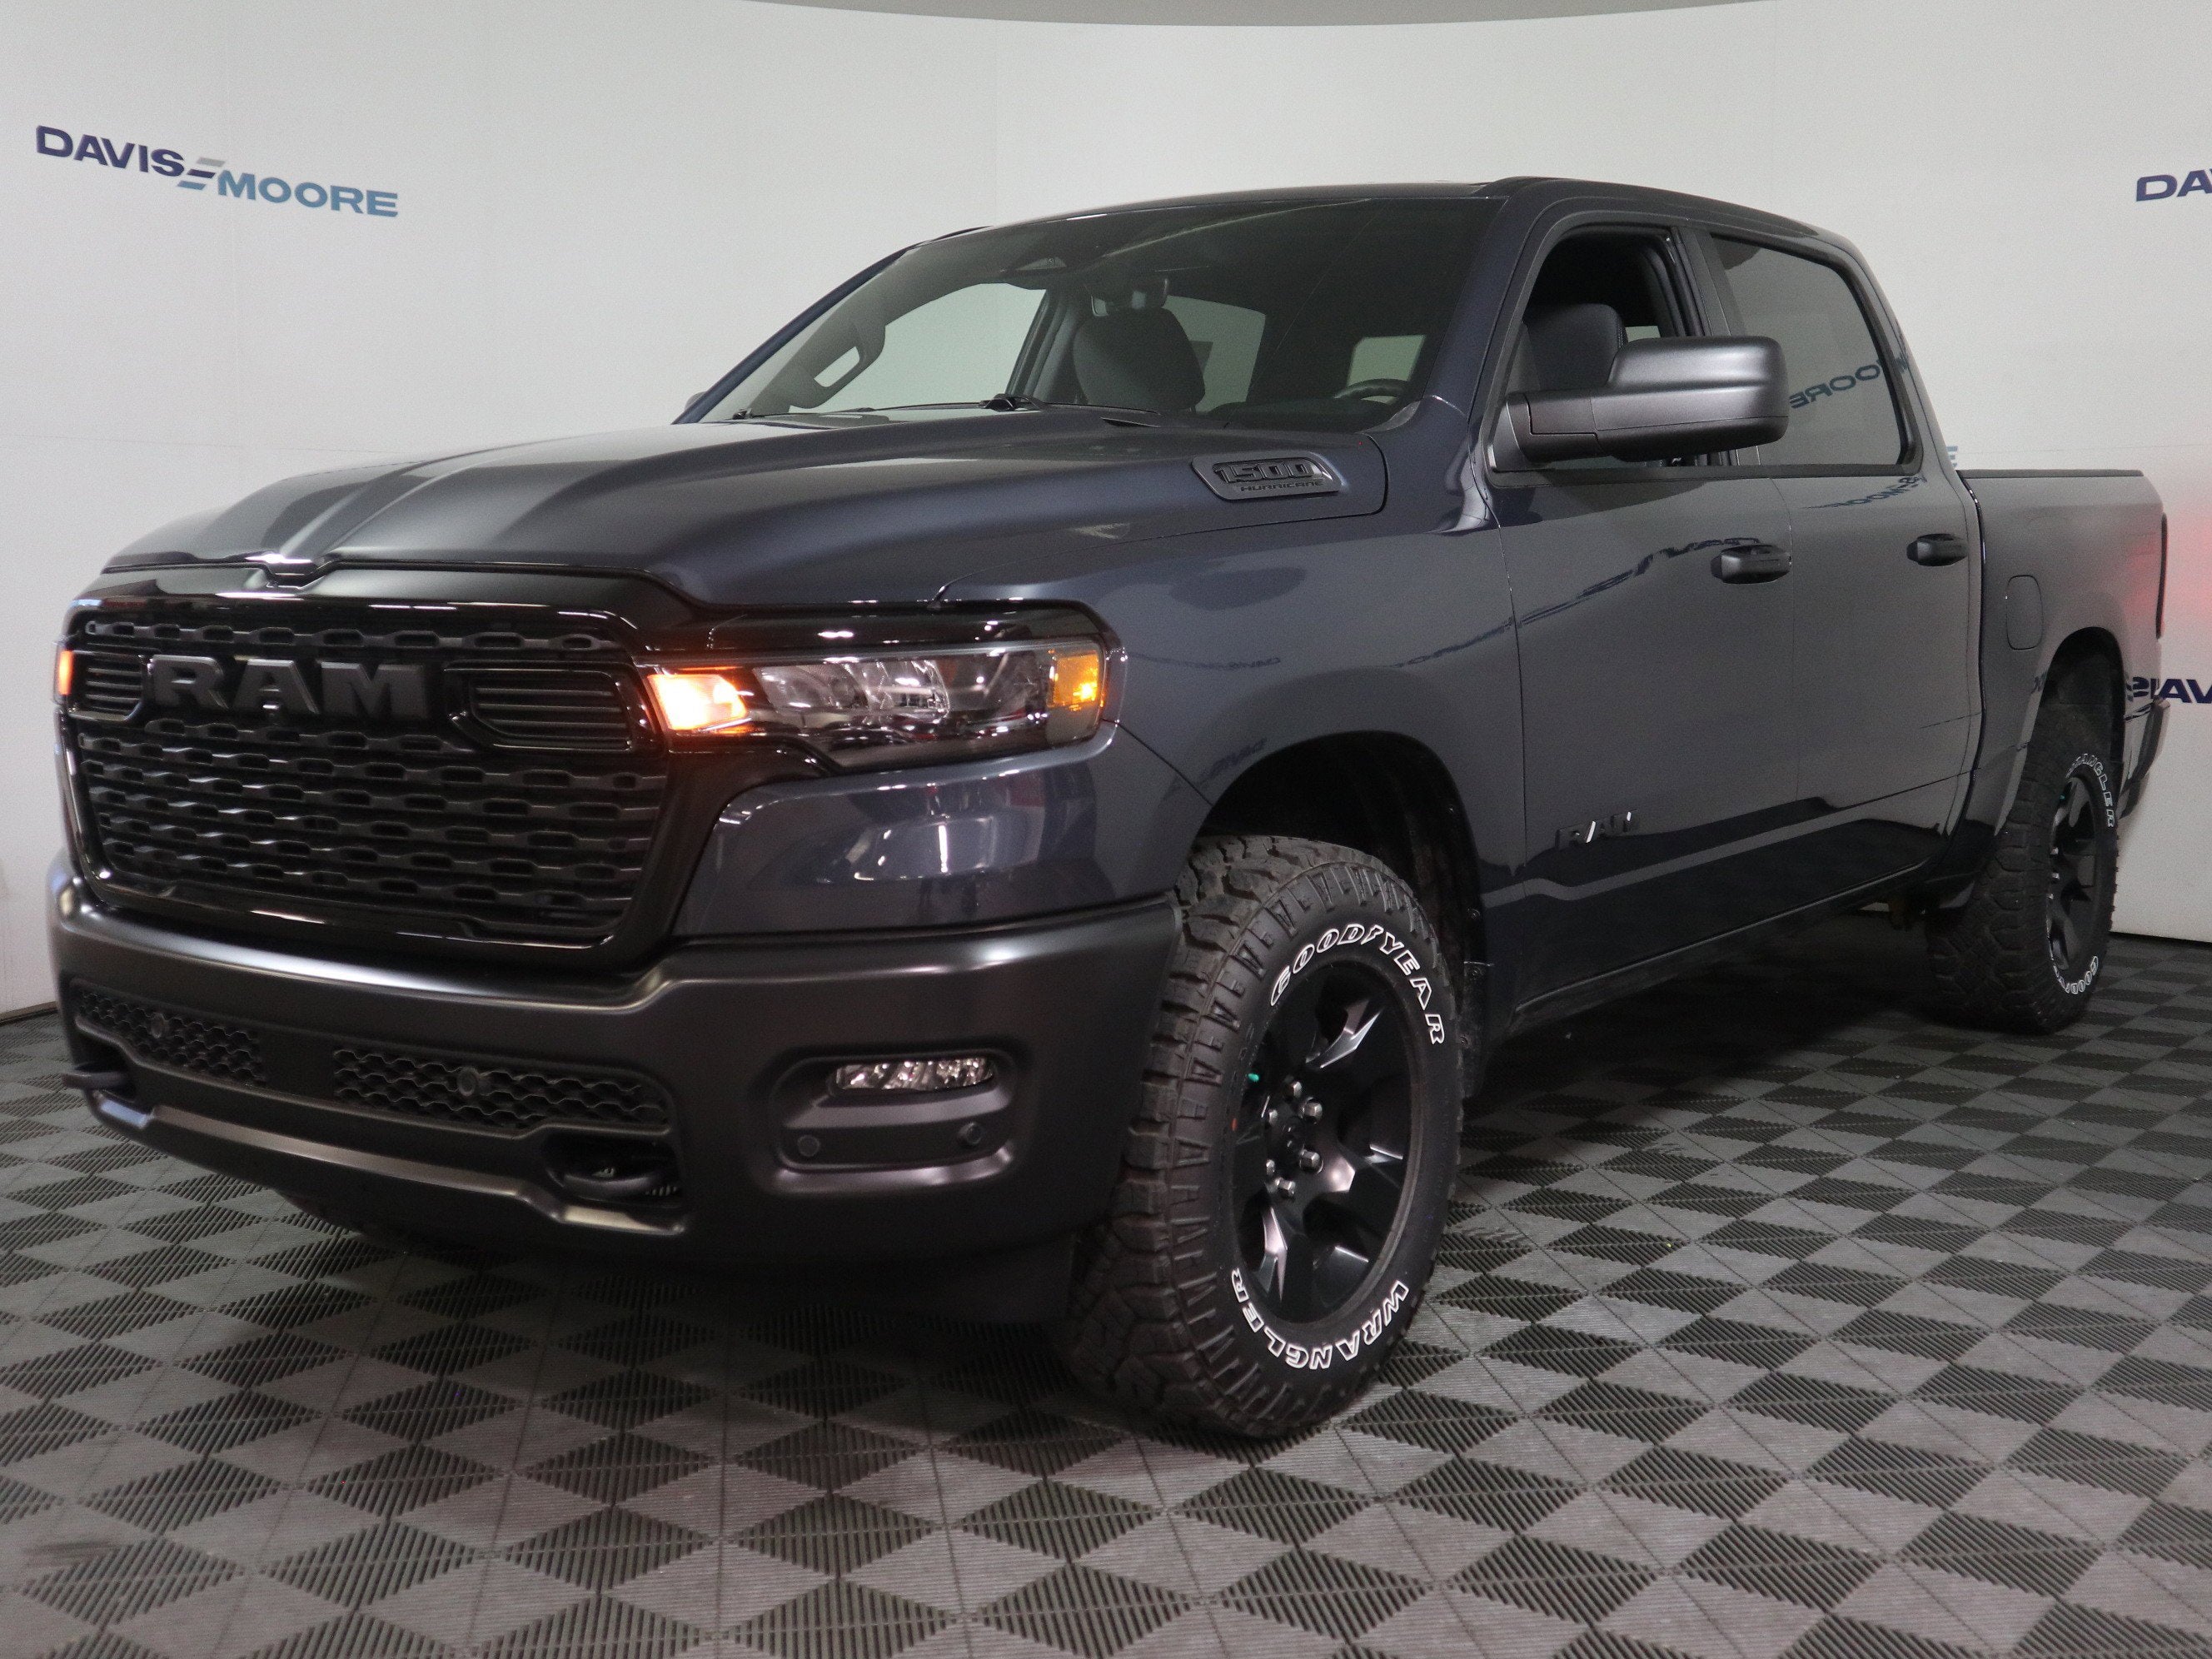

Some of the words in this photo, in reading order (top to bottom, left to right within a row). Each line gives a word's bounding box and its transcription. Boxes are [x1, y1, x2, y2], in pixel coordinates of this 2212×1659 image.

[36, 125, 185, 177] DAVIS
[218, 170, 399, 217] MOORE
[2135, 168, 2212, 202] DA
[1214, 461, 1314, 484] 1500
[150, 654, 430, 720] RAM
[1270, 924, 1445, 1044] GOODYEAR
[1231, 1267, 1410, 1370] WRANGLER
